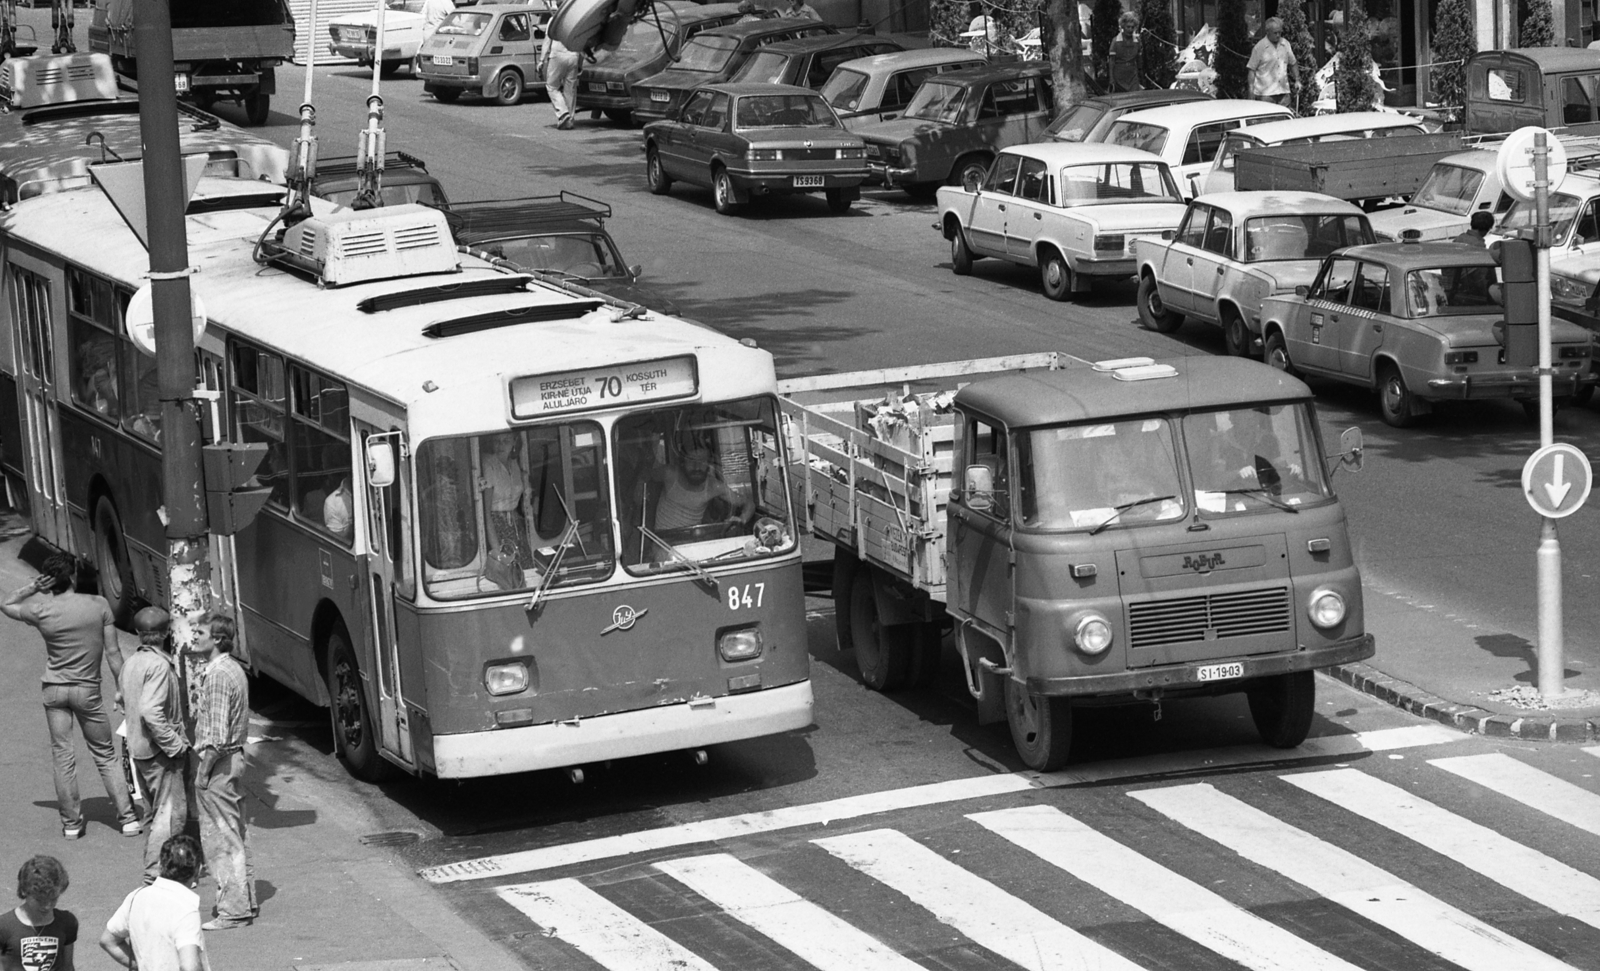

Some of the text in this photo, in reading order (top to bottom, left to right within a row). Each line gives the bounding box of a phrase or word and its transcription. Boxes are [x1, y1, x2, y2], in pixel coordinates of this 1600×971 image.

[796, 175, 823, 186] TS9368
[626, 369, 667, 382] KOSSUTH
[540, 377, 586, 391] ERZSÉBET
[595, 376, 622, 399] 70
[640, 382, 657, 392] TÉR
[543, 397, 588, 410] ALULJÁRÓ
[1182, 553, 1225, 571] ROBUR
[728, 583, 765, 610] 847
